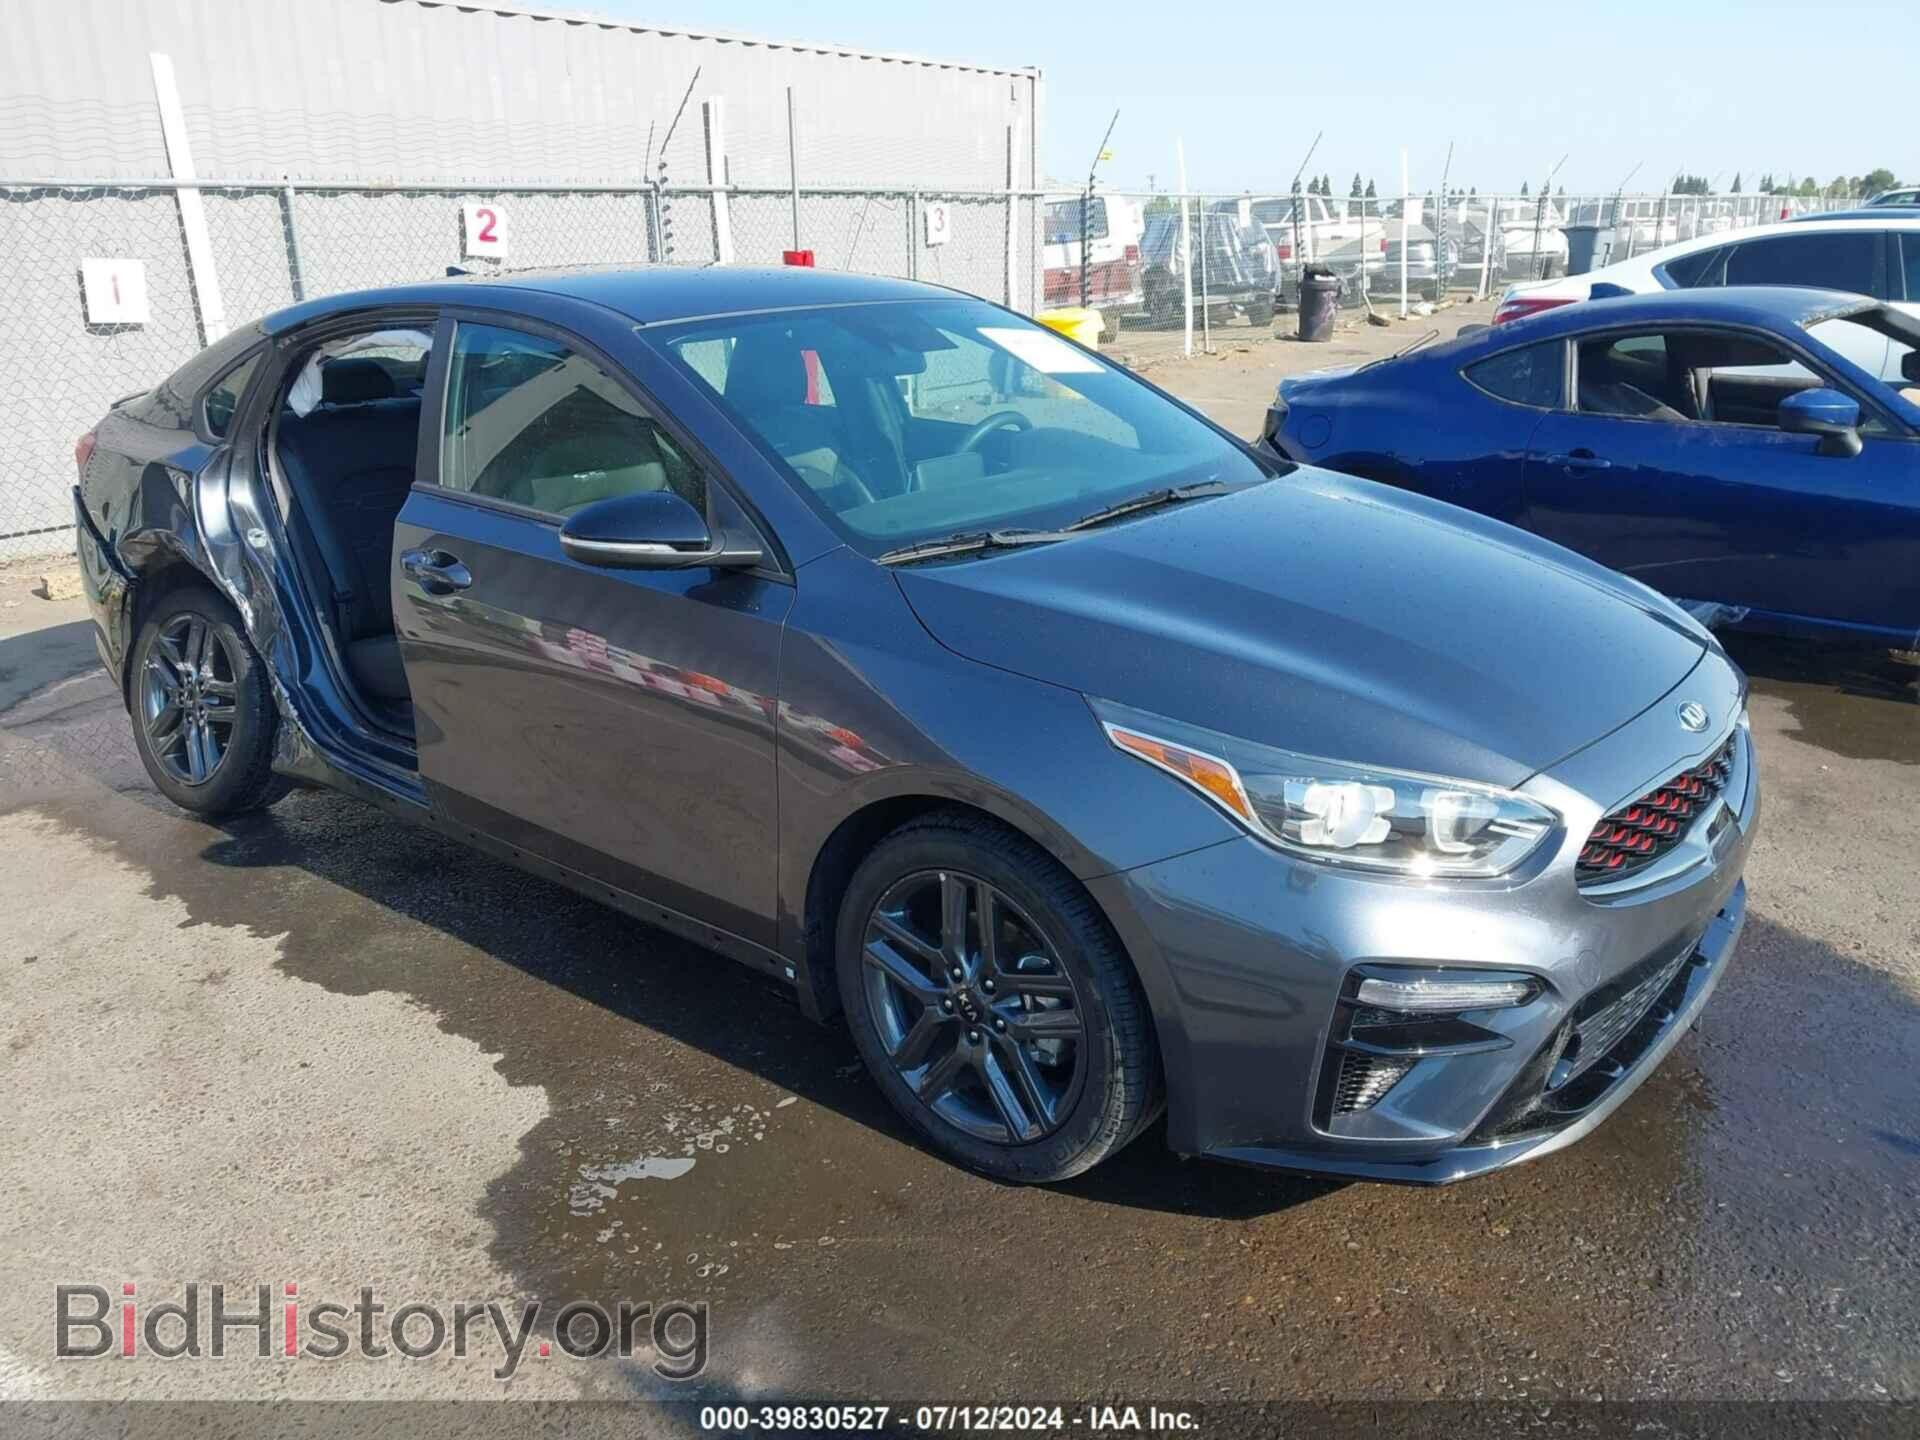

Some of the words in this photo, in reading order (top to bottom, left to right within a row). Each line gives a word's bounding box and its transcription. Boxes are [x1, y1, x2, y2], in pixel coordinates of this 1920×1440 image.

[475, 208, 498, 242] 2
[934, 207, 945, 232] 3
[111, 273, 121, 305] 1
